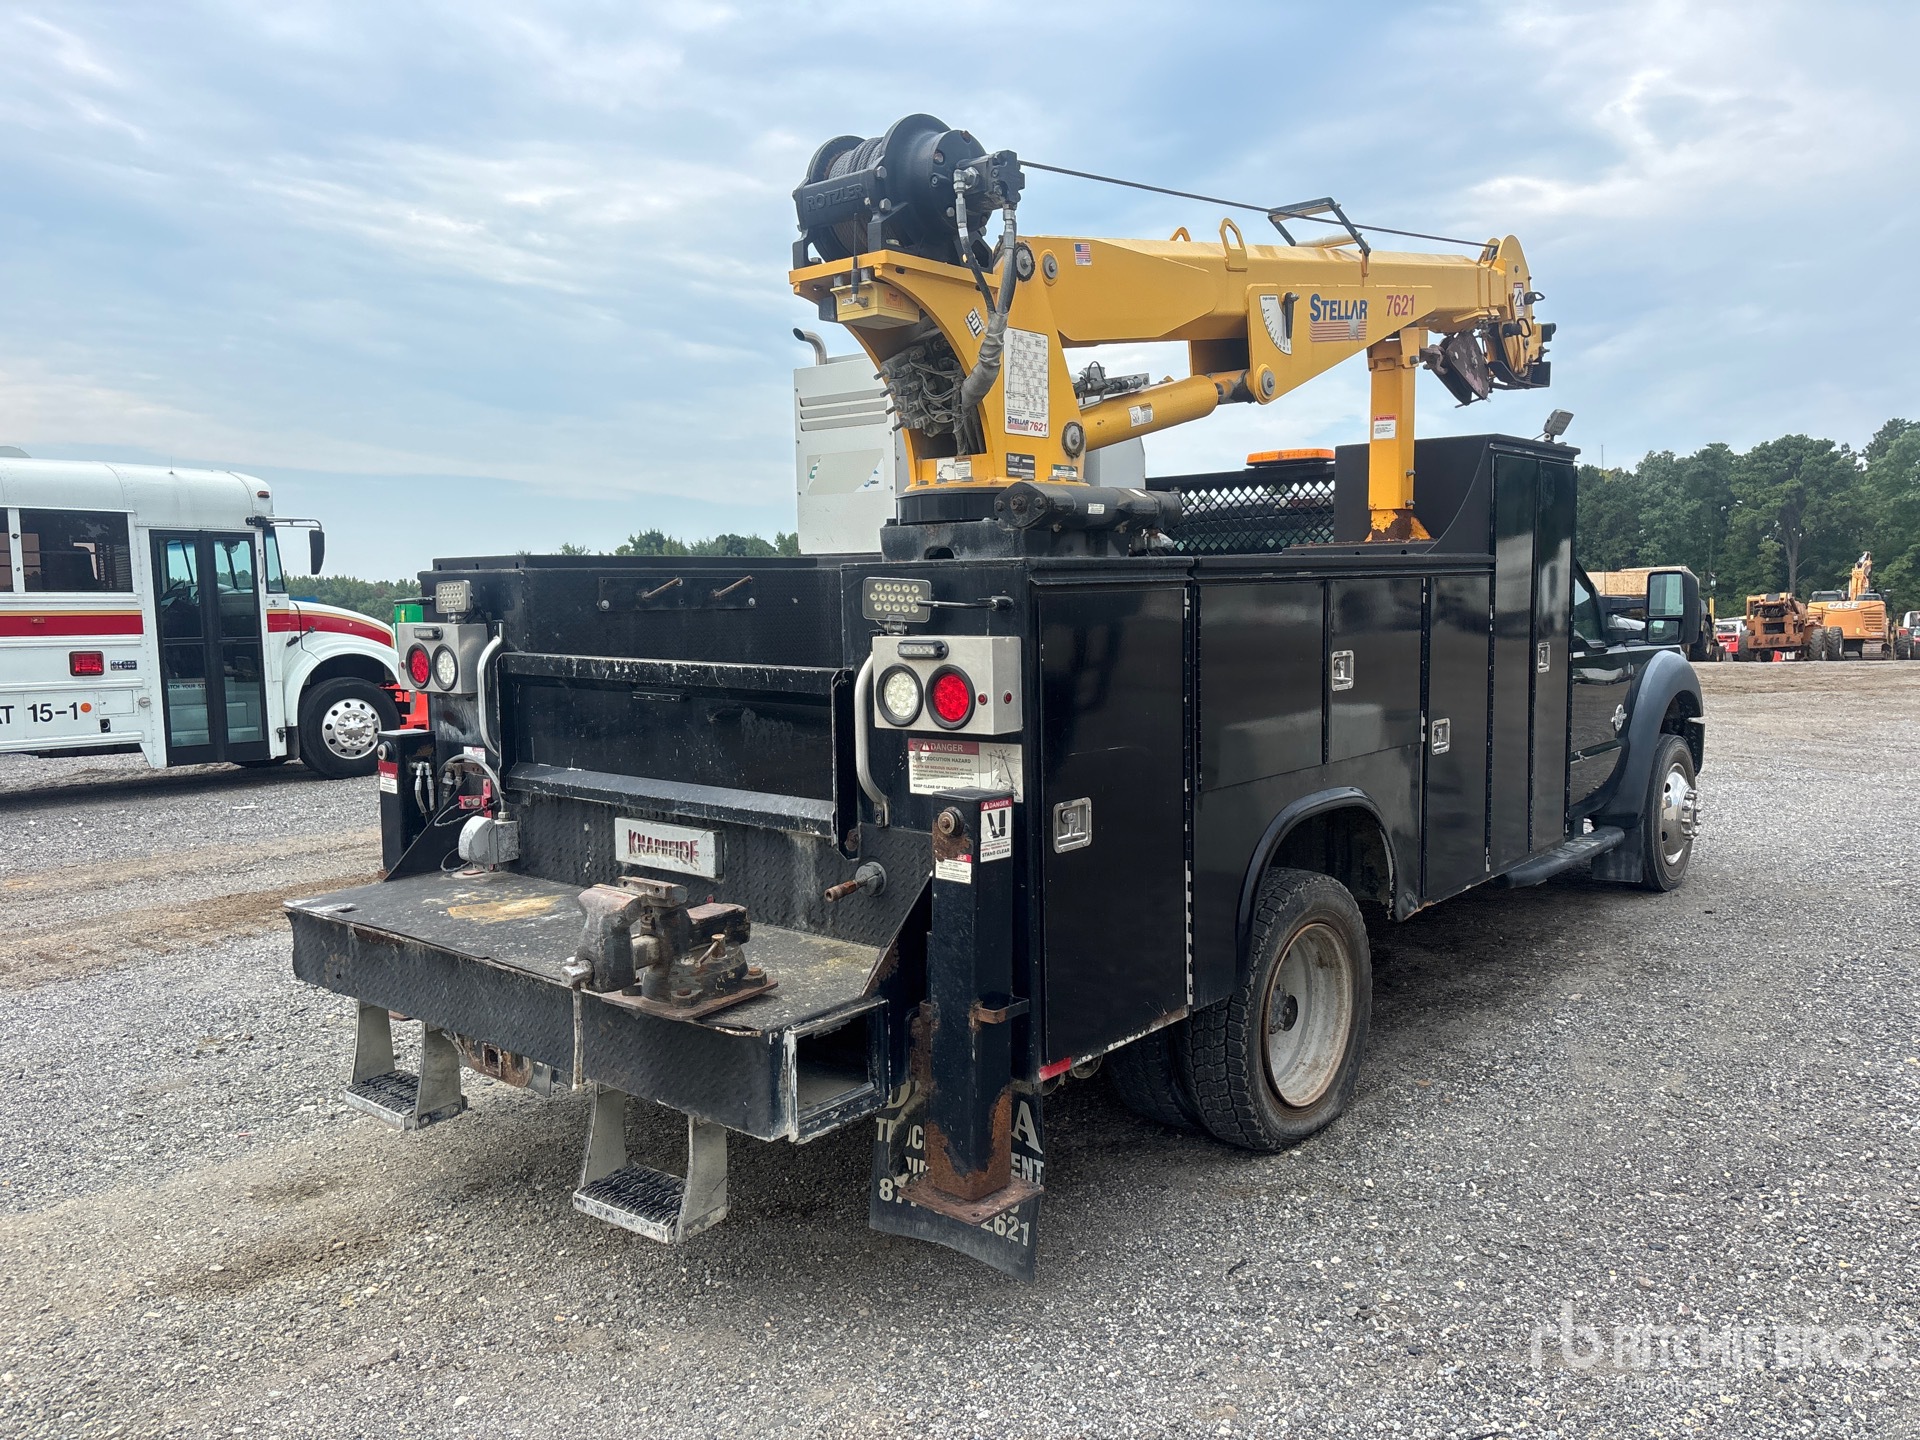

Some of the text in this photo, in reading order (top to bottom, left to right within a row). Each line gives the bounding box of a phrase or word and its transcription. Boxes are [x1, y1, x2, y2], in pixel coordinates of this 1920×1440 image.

[806, 183, 863, 212] ROTZLER
[1310, 293, 1415, 322] STELLAR 7621
[1007, 416, 1047, 432] STELLAR 7621
[1827, 601, 1859, 609] CASE
[27, 702, 79, 723] 15-1
[930, 743, 964, 752] DANGER
[988, 800, 1010, 808] DANGER
[982, 850, 996, 858] STAND
